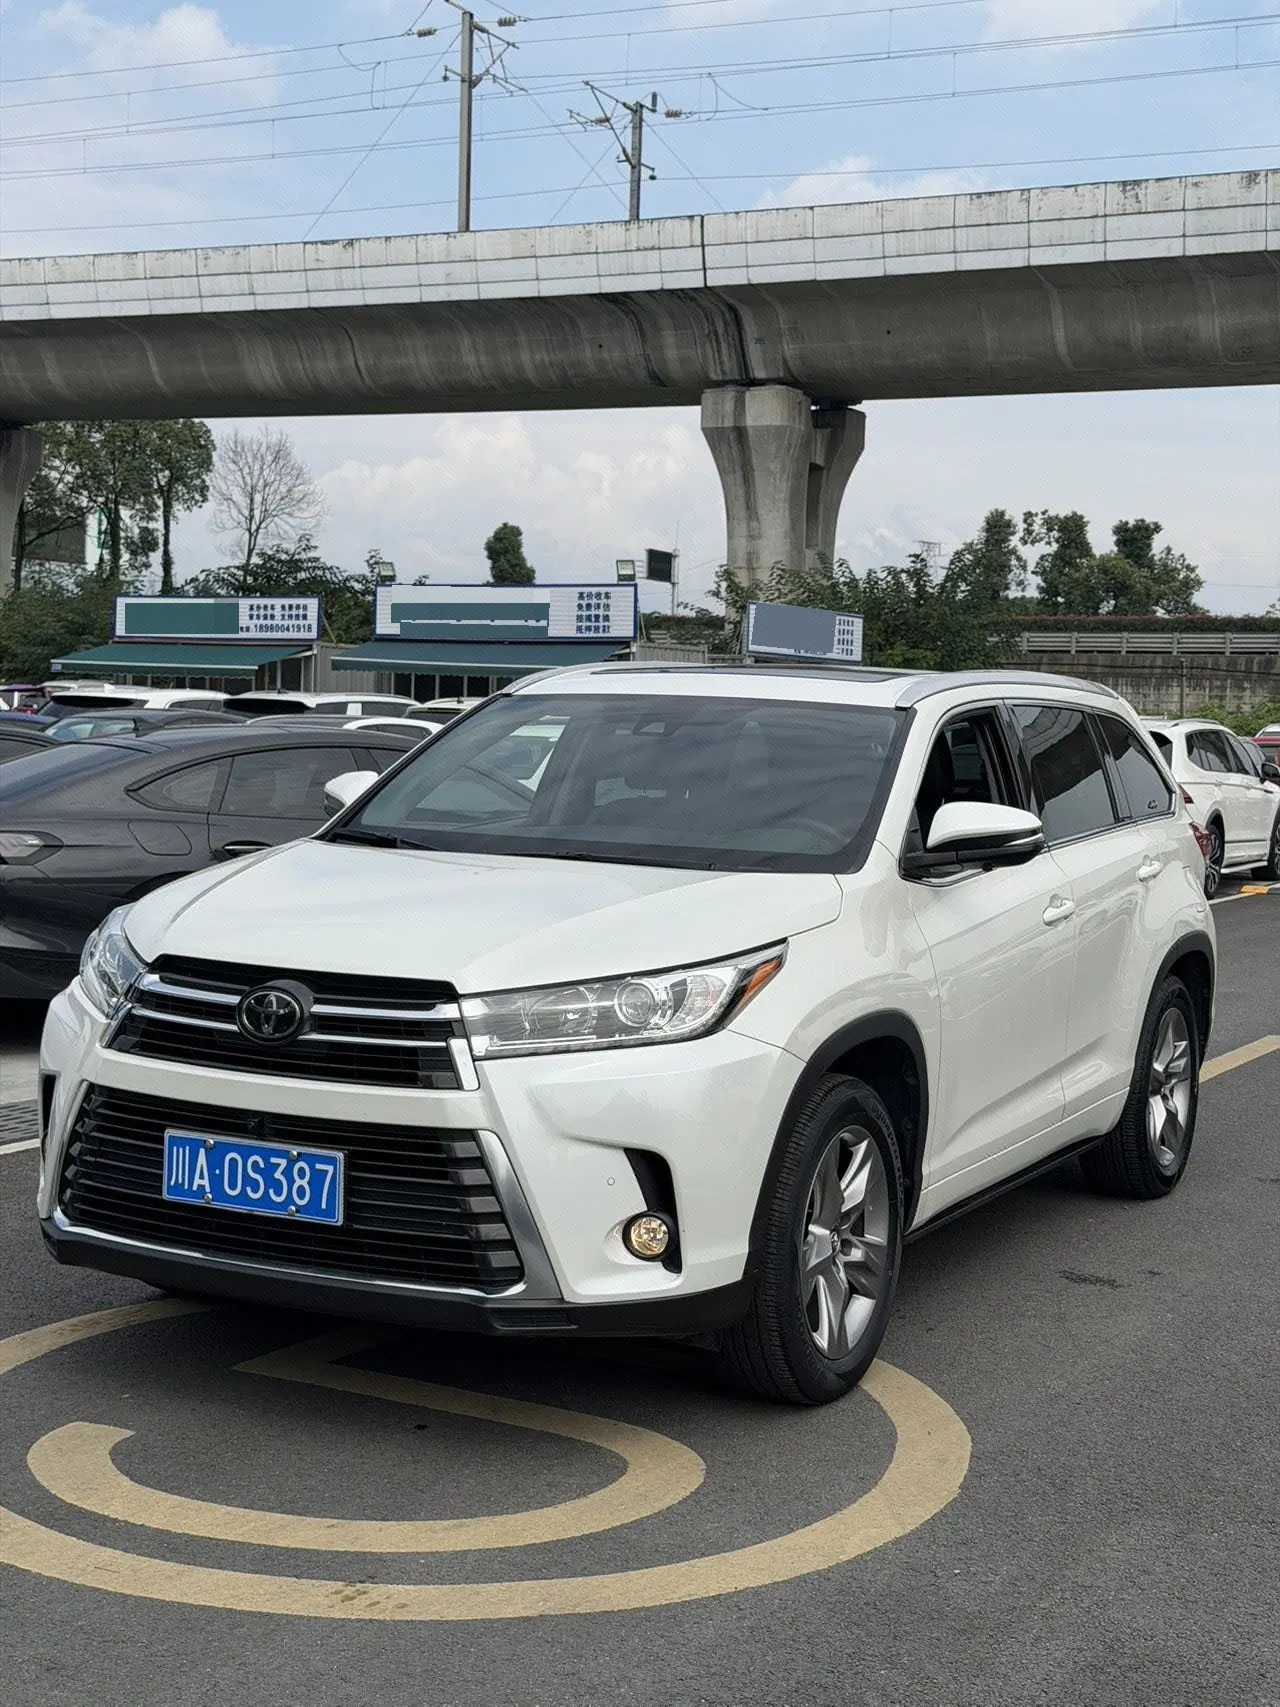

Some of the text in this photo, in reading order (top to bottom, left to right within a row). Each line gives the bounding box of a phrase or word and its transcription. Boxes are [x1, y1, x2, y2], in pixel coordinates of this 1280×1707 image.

[577, 591, 611, 601] 高价收车
[577, 602, 611, 612] 免费评估
